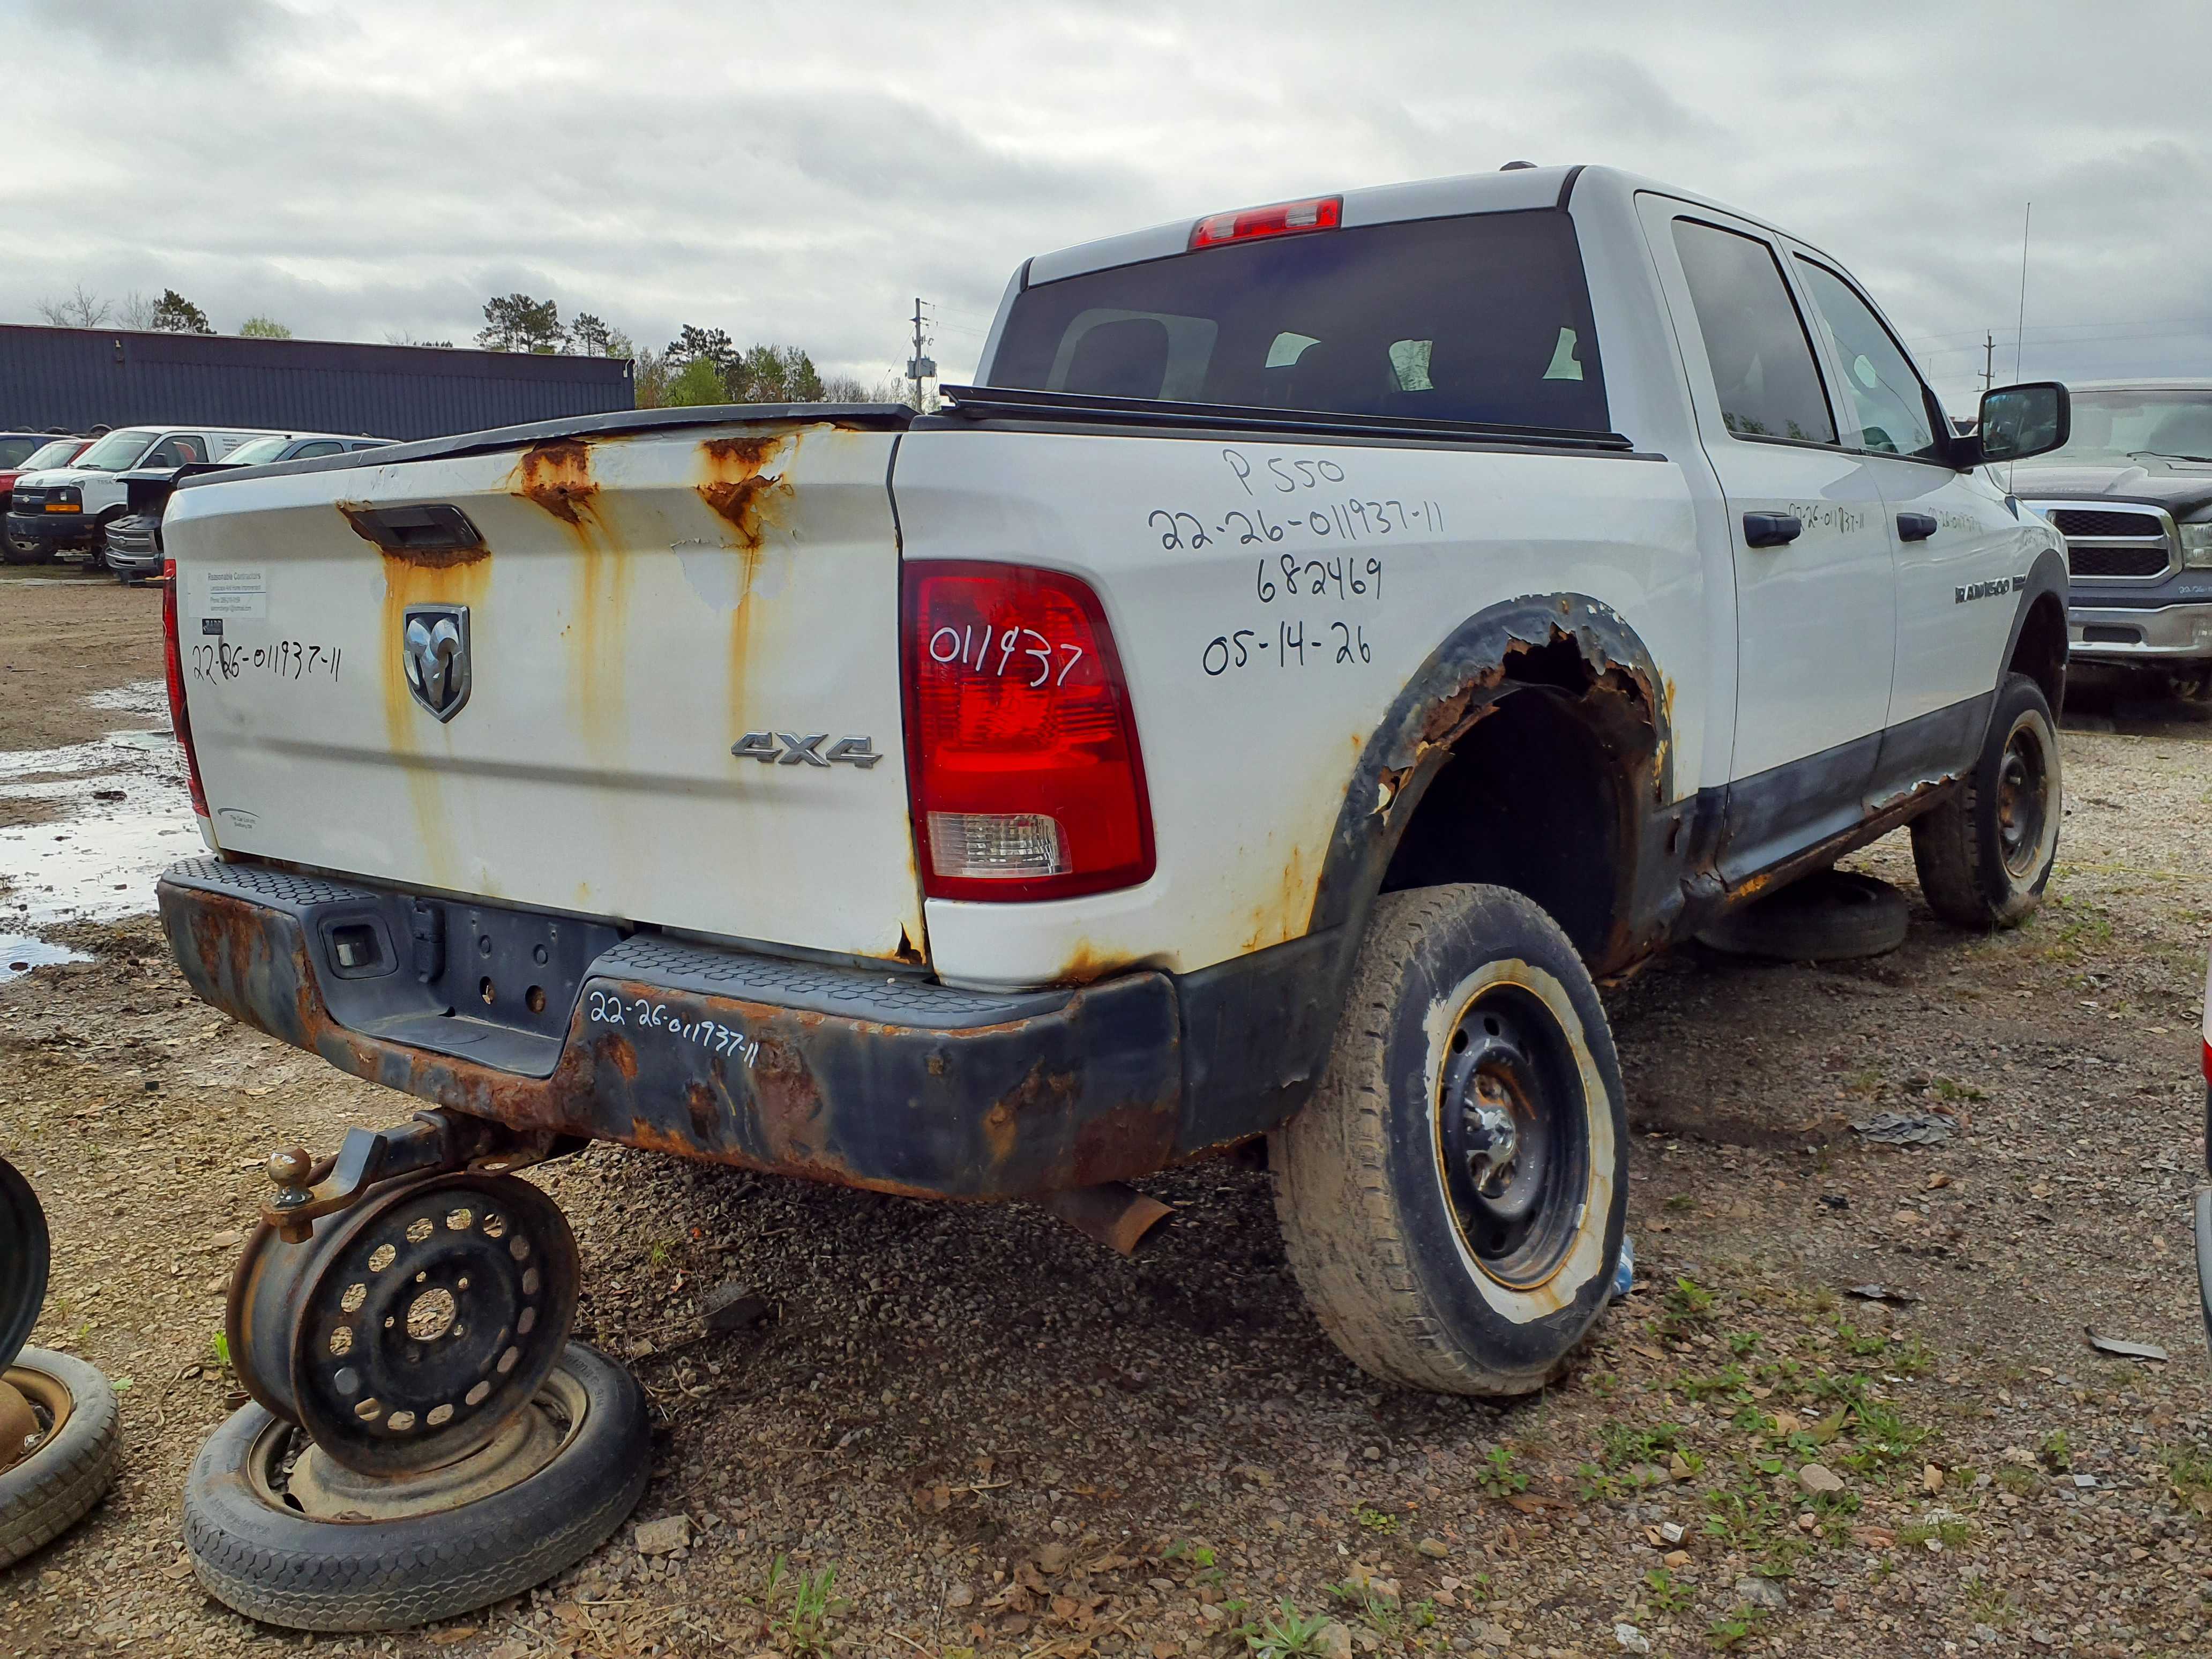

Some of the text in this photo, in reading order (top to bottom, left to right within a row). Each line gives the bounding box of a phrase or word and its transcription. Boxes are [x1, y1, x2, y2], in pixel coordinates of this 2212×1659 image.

[1222, 449, 1345, 496] P 550
[1148, 498, 1444, 550] 22-26-011937-11
[1258, 554, 1381, 603] 682469
[930, 625, 1082, 687] 011937
[1202, 621, 1371, 676] 05-14-26
